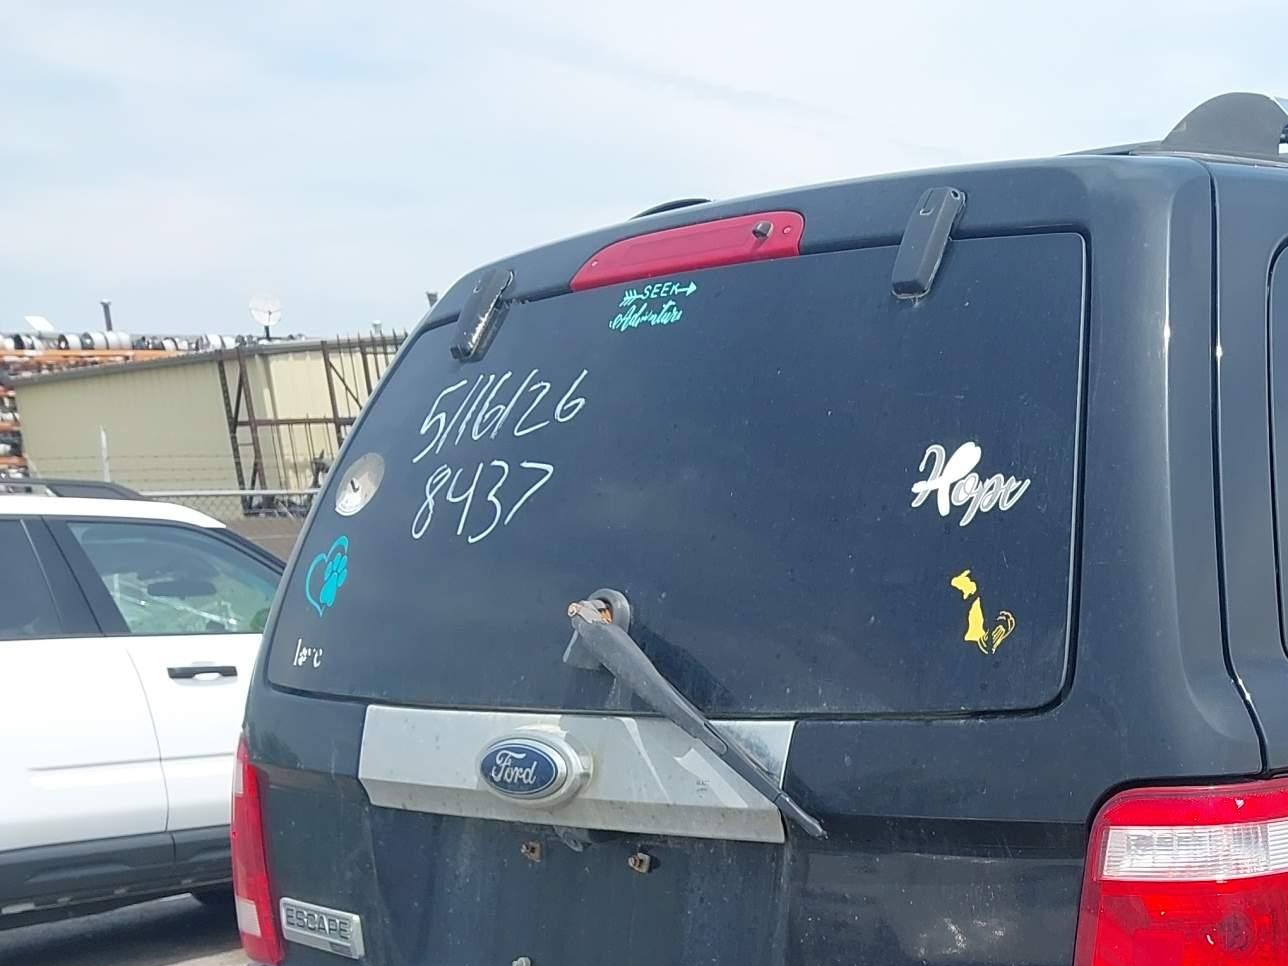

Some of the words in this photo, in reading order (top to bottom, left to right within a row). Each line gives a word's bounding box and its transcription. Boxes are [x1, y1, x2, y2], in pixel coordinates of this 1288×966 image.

[641, 281, 680, 300] SEEK
[412, 369, 588, 464] 5/16/26
[411, 460, 554, 544] 8437
[911, 441, 1031, 526] Hope
[491, 750, 538, 785] Ford
[285, 907, 351, 940] ESCAPE
